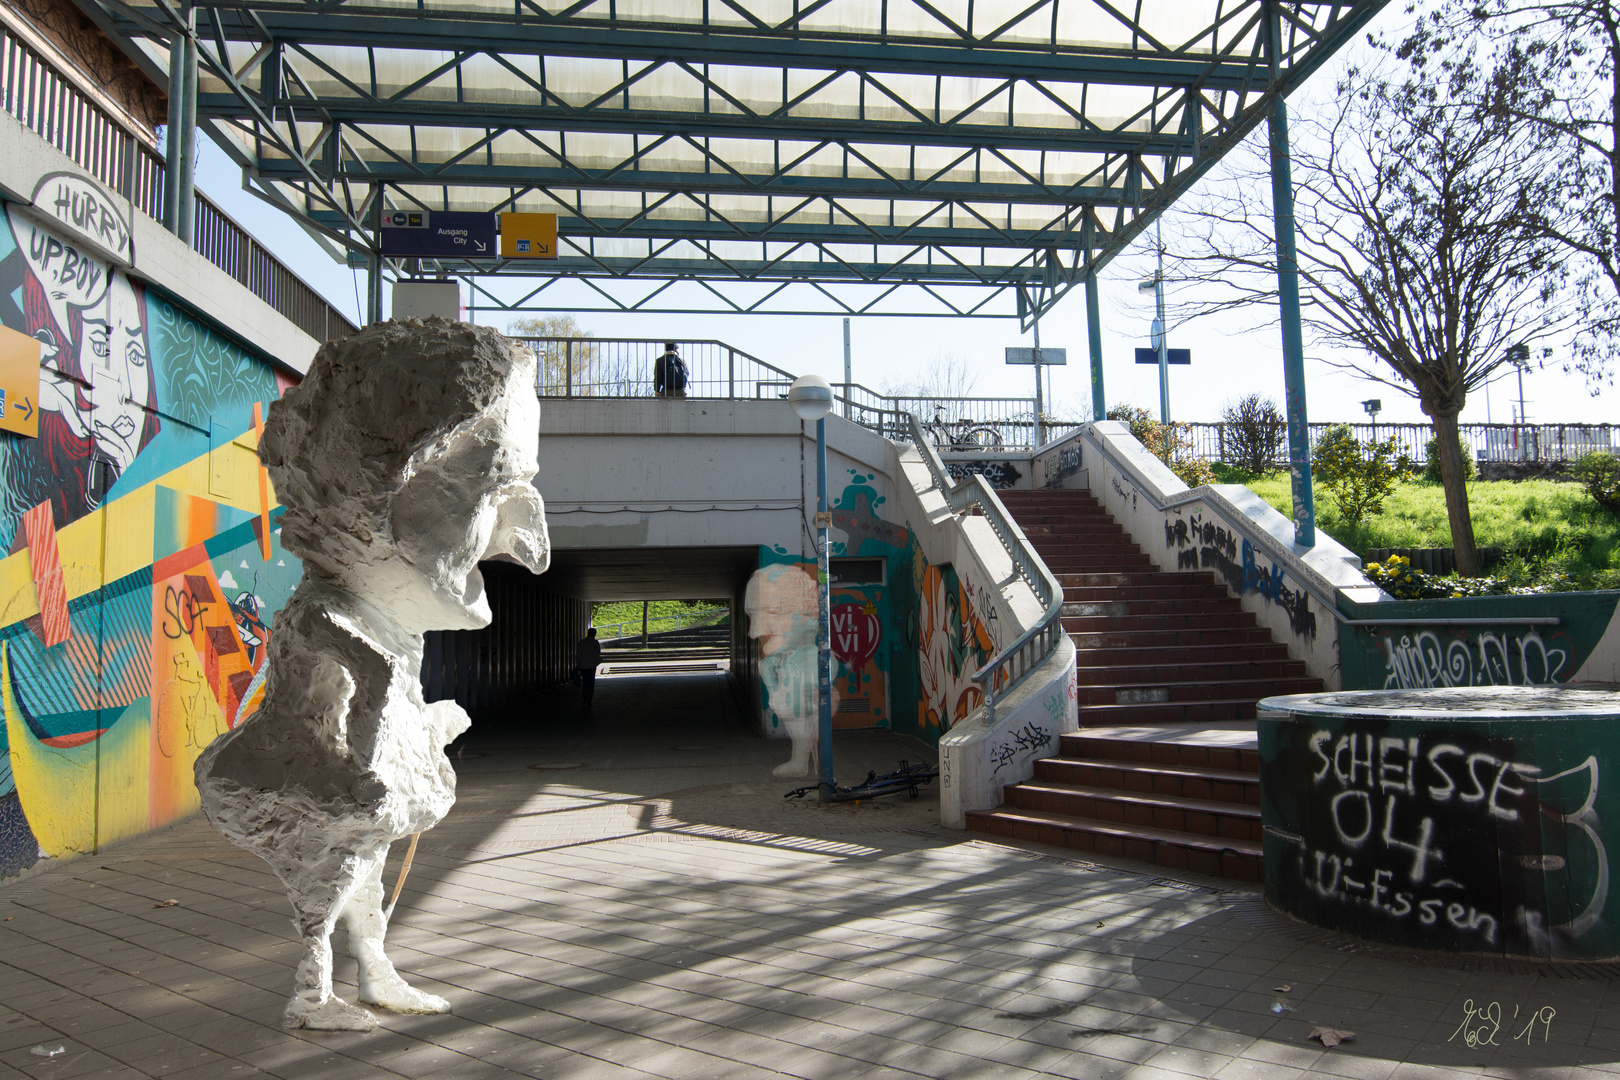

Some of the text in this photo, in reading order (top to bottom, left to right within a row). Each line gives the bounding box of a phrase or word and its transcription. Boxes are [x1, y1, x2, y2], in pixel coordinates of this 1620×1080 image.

[54, 184, 129, 254] HURRY
[437, 228, 468, 237] Ausgang
[453, 236, 468, 246] City
[58, 246, 101, 300] BOY
[1309, 730, 1541, 820] SCHEISSE
